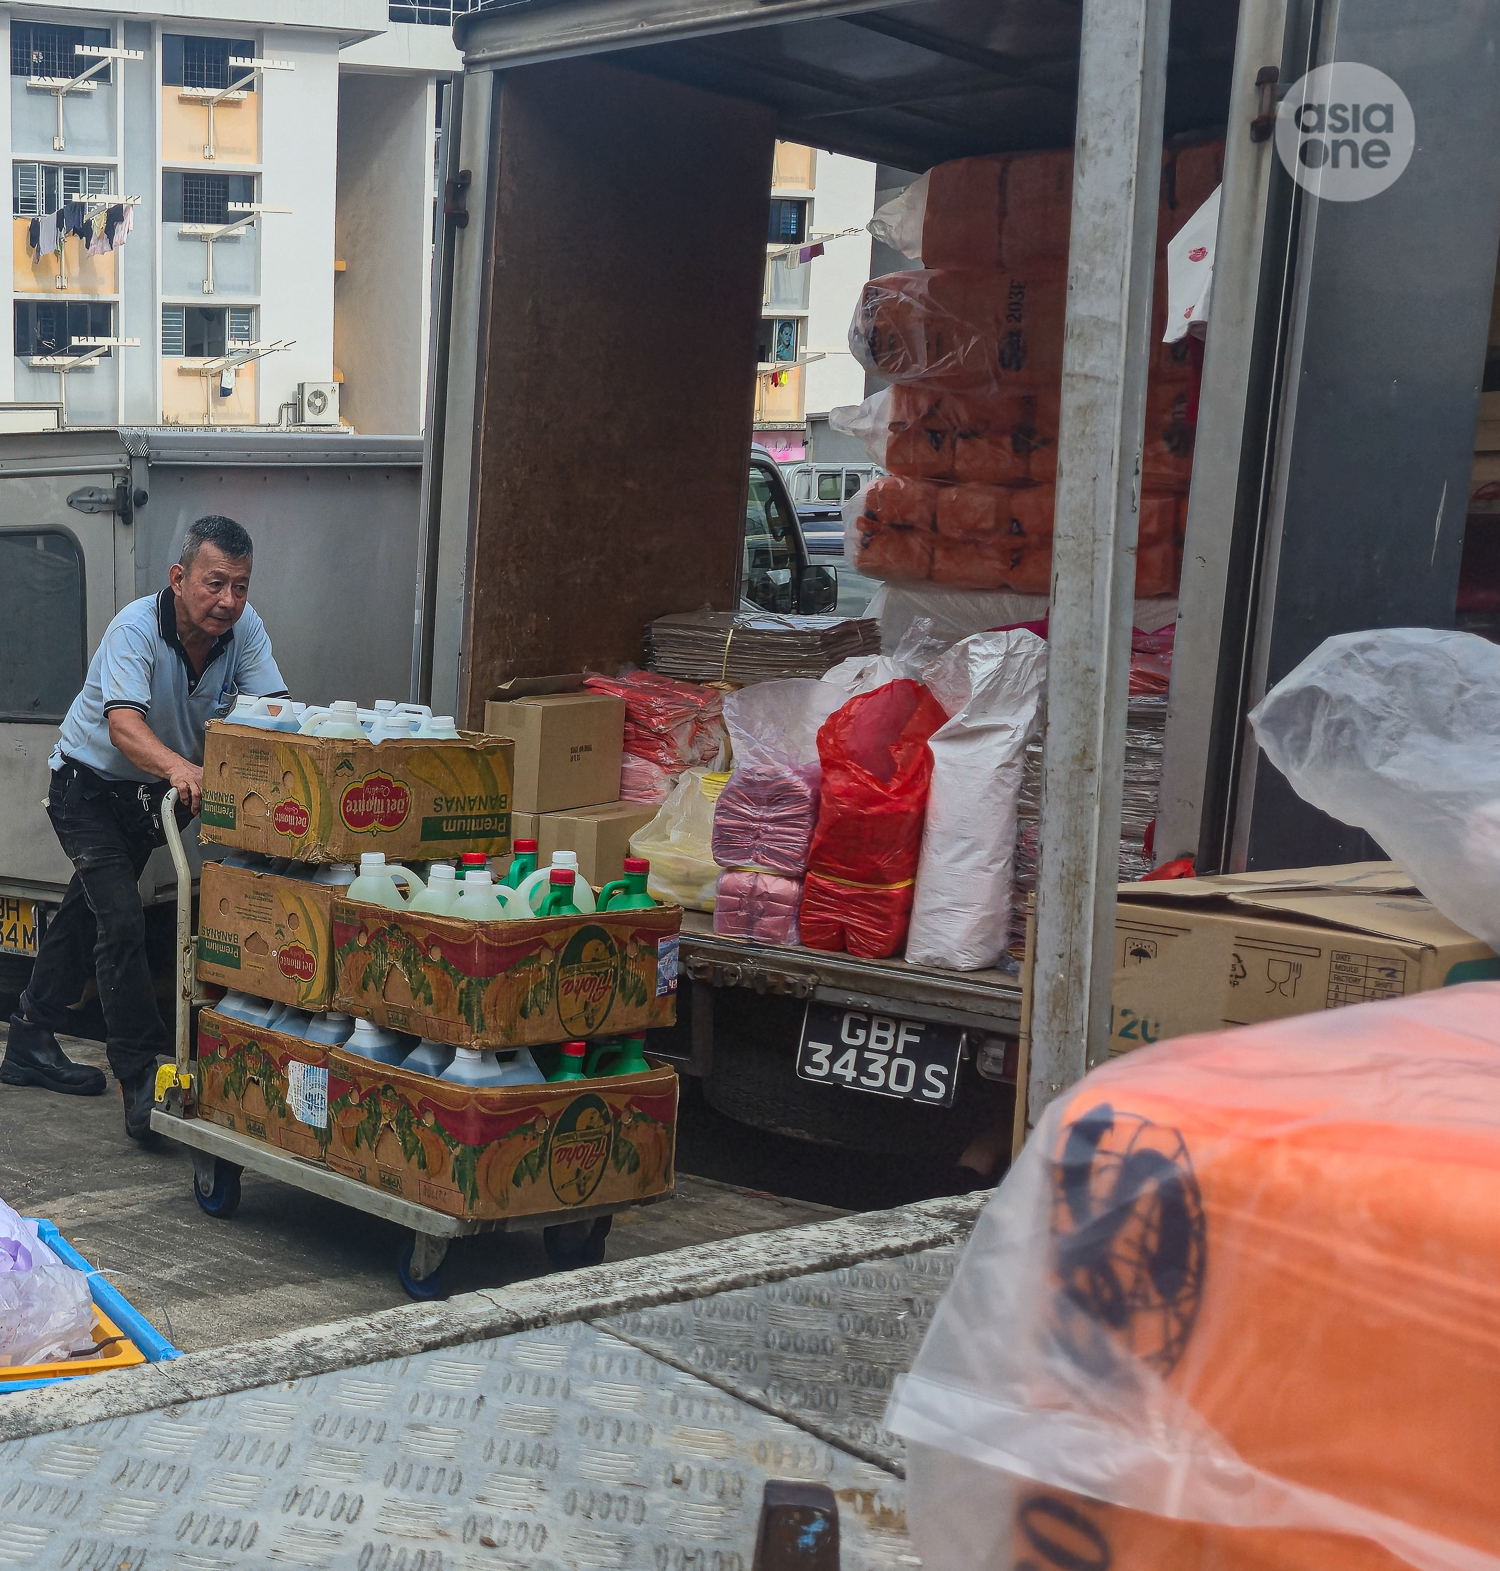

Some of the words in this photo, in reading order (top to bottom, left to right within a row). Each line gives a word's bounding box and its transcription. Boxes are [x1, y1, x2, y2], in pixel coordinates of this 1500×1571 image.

[201, 789, 235, 805] BANANAS
[365, 784, 391, 797] Quality
[346, 796, 385, 815] Monte
[386, 797, 405, 814] Del
[433, 794, 508, 813] BANANAS
[204, 804, 235, 819] Premium
[275, 812, 295, 826] Monte
[295, 816, 307, 828] Del
[442, 817, 507, 835] Premium
[201, 925, 239, 943] BANANAS
[205, 940, 239, 958] Premium
[279, 956, 300, 970] Monte
[1335, 953, 1352, 962] DATE
[301, 960, 313, 973] Del
[1334, 964, 1359, 974] MOULD
[560, 968, 614, 1003] Aloha
[1333, 974, 1362, 985] FACTORY
[1374, 980, 1393, 990] SHIFT
[840, 1011, 926, 1055] GBF
[554, 1135, 608, 1171] Aloha
